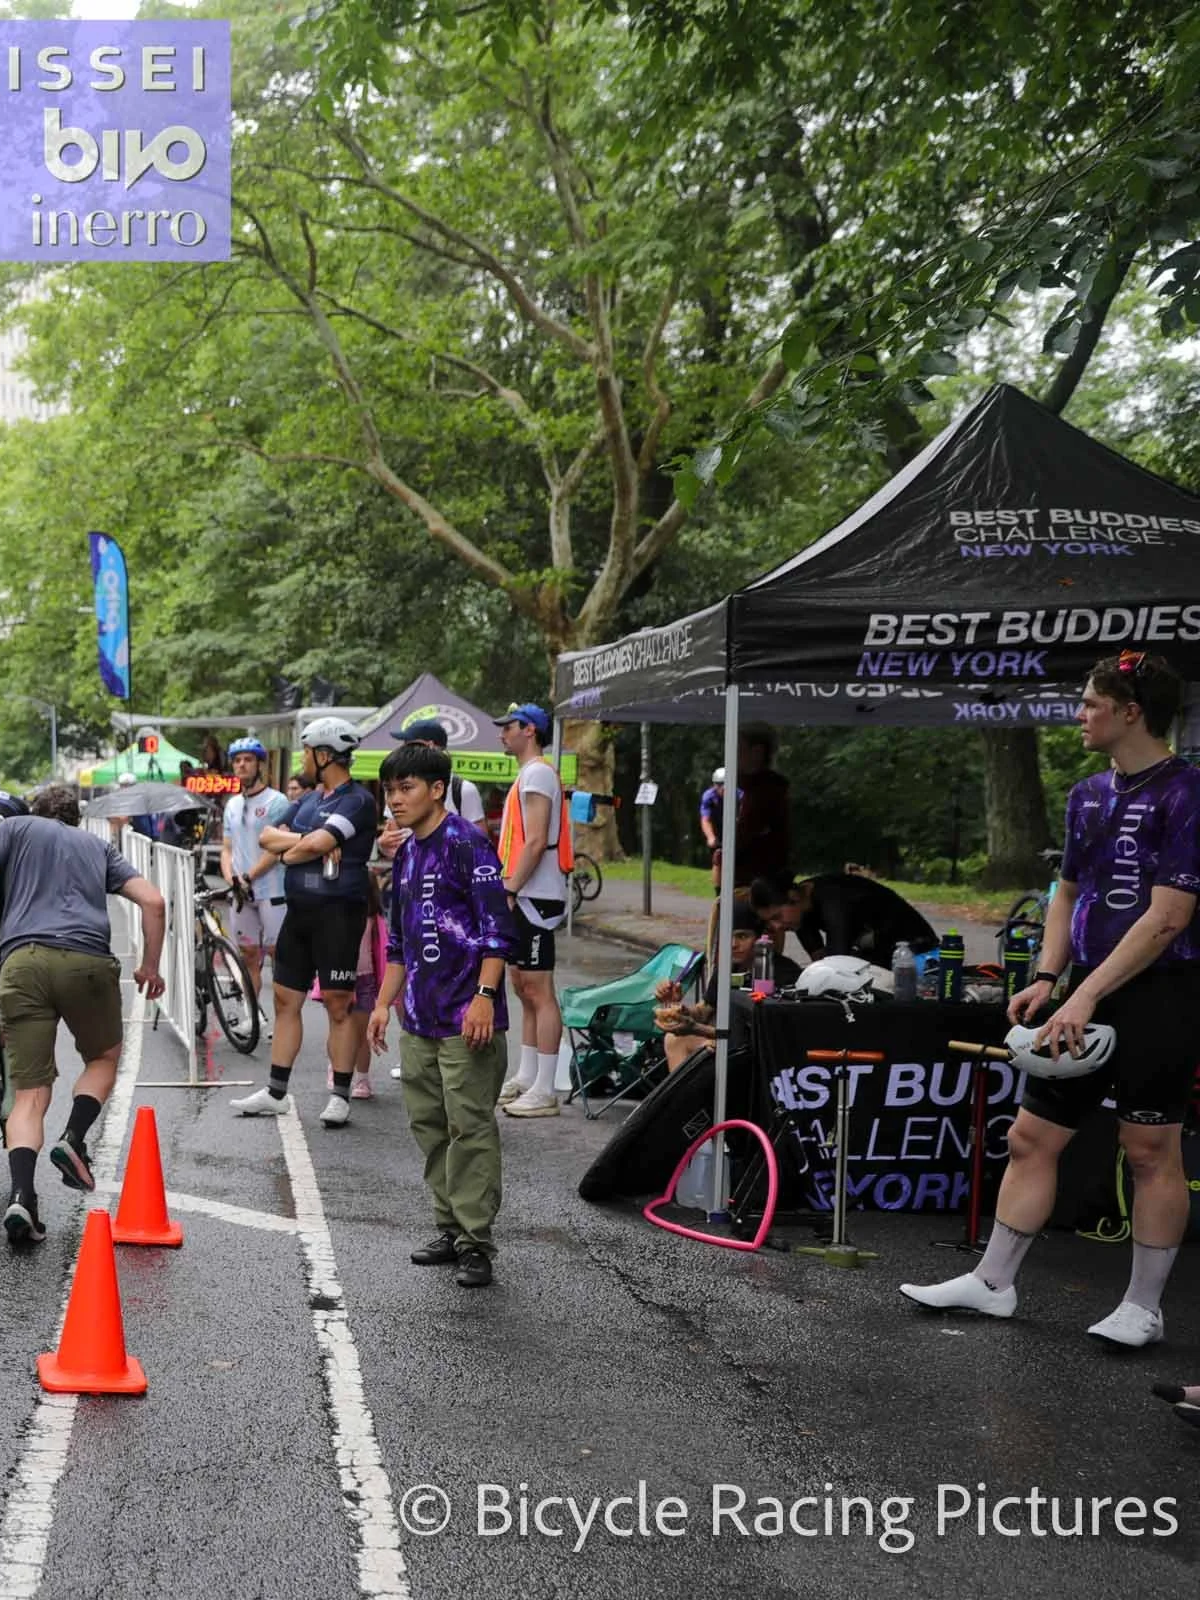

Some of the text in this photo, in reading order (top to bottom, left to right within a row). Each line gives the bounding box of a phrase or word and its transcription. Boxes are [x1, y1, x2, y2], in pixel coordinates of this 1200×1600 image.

[950, 508, 1200, 534] BEST BUDDIES
[953, 526, 1165, 545] CHALLENGE
[960, 542, 1137, 557] NEW YORK
[863, 604, 1200, 647] BEST BUDDIES
[573, 624, 692, 686] BEST BUDDIES CHALLENGE
[855, 650, 1050, 678] NEW YORK
[457, 759, 505, 772] PORT
[1105, 803, 1155, 910] inerro
[422, 873, 442, 962] inerro
